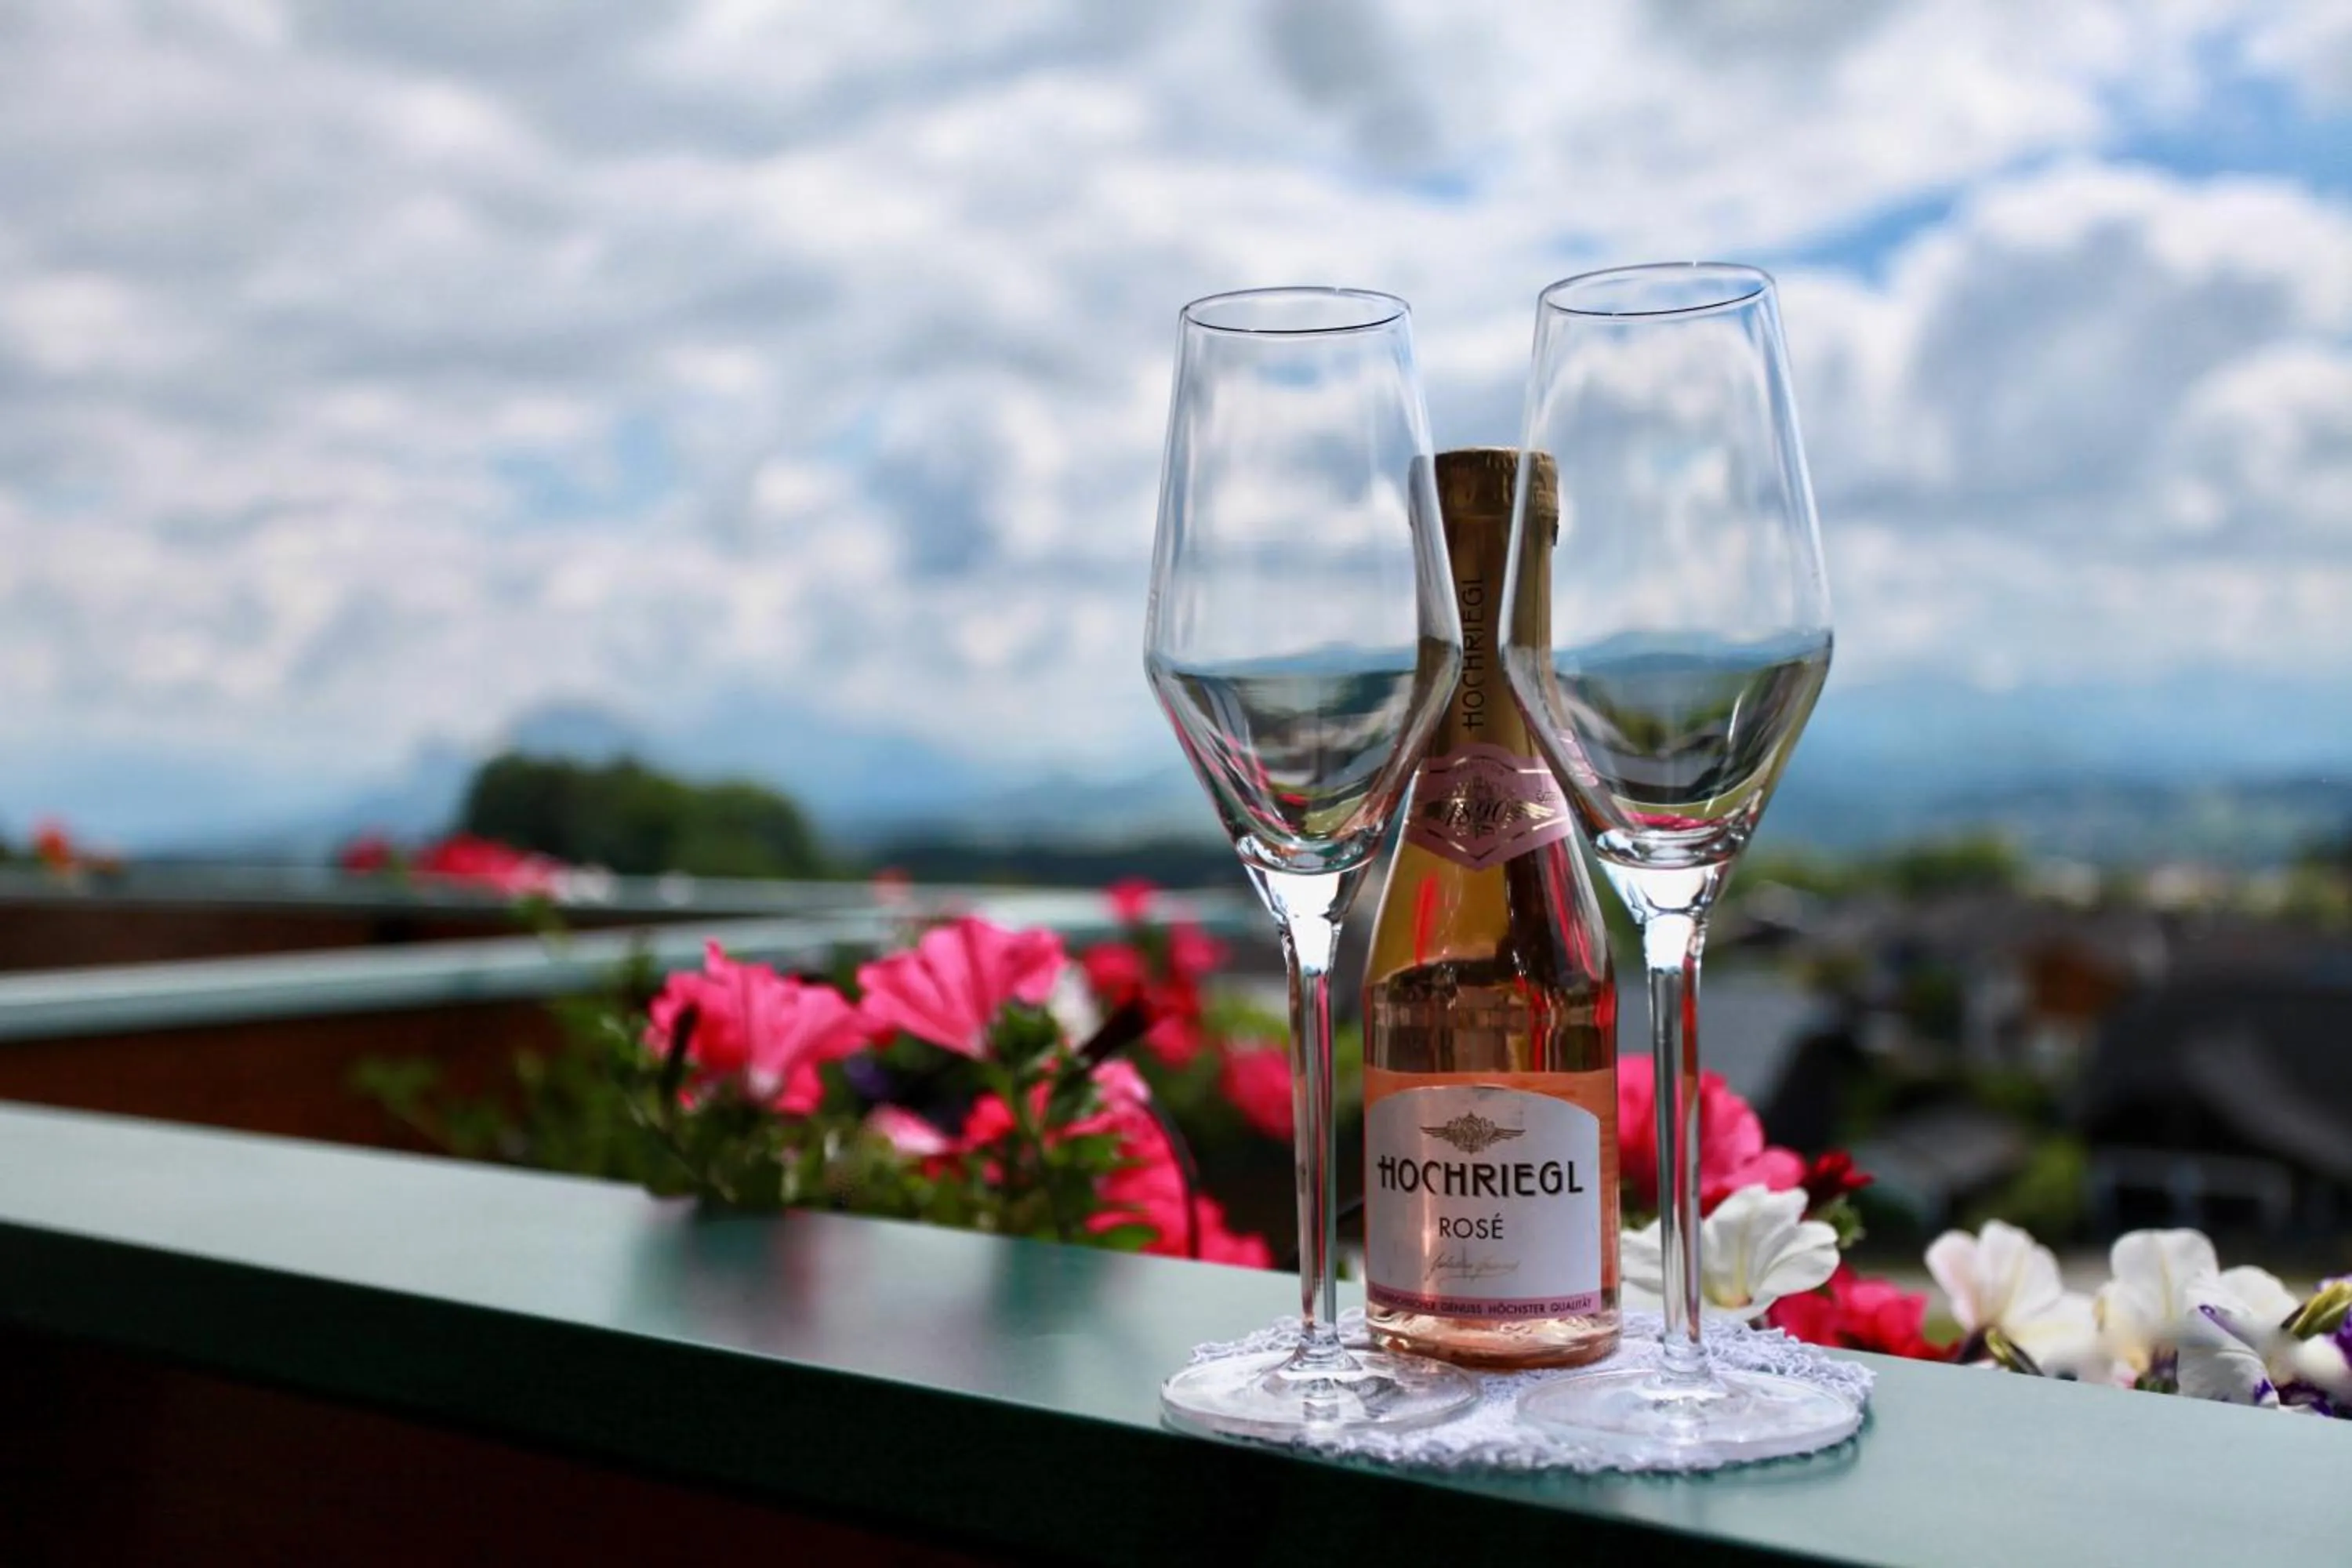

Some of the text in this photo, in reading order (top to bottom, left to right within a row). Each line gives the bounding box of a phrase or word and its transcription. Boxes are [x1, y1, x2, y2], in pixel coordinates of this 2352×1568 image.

[1461, 570, 1484, 731] HOCHRIEGL
[1377, 1155, 1584, 1198] HOCHRIEGL
[1439, 1213, 1504, 1240] ROSÉ
[1488, 1301, 1546, 1316] HÖCHSTER
[1550, 1295, 1592, 1312] QUALITÄT
